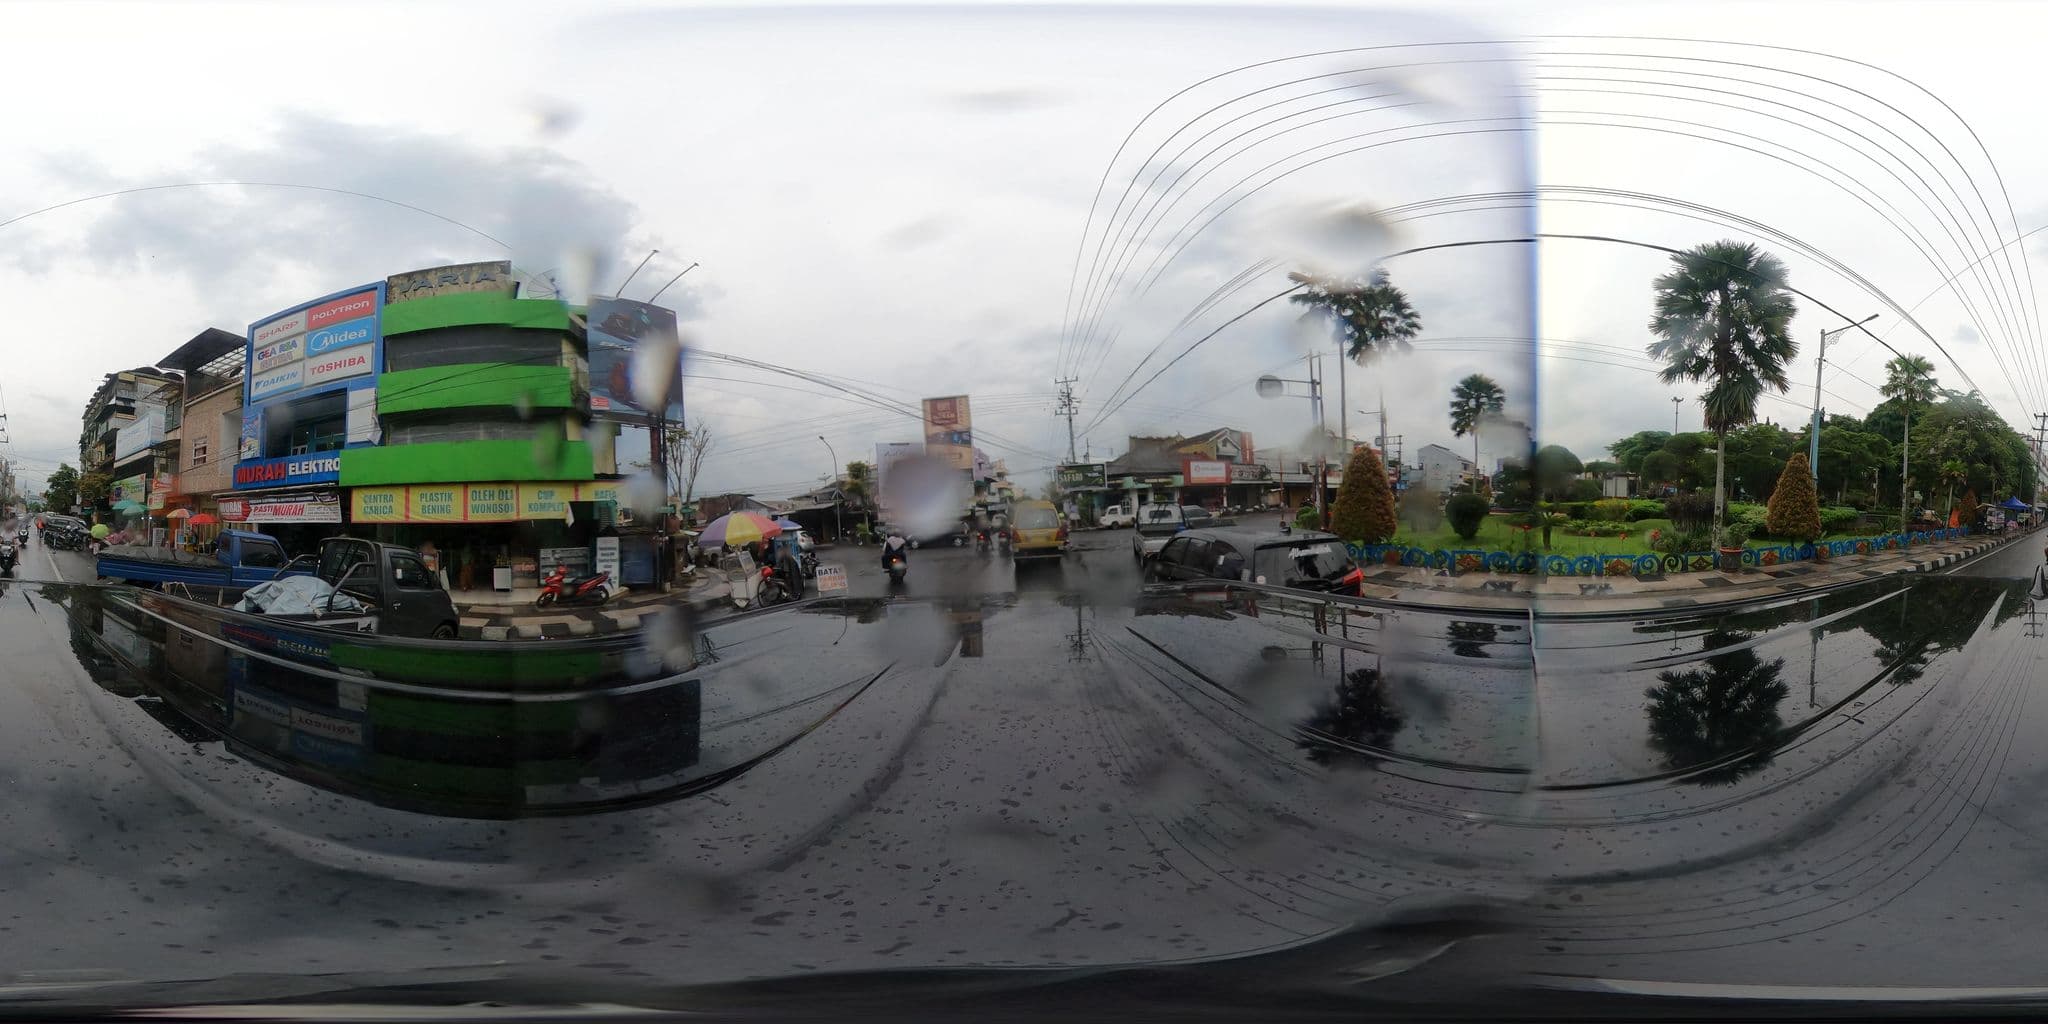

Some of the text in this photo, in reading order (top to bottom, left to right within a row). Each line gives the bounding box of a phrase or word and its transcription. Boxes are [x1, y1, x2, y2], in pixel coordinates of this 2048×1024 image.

[400, 271, 497, 293] VARIA
[312, 300, 370, 321] POLYTRON
[258, 320, 299, 341] SHARP
[321, 329, 367, 346] Midea
[257, 346, 277, 361] GEA
[310, 356, 366, 376] TOSHIBA
[262, 371, 298, 388] DAIKIN
[236, 458, 341, 484] MURAH ELEKTRO
[420, 492, 453, 502] PLASTIK
[471, 489, 495, 501] OLEH
[252, 505, 273, 513] PASTI
[273, 504, 305, 517] MURAH
[421, 503, 451, 514] BENING
